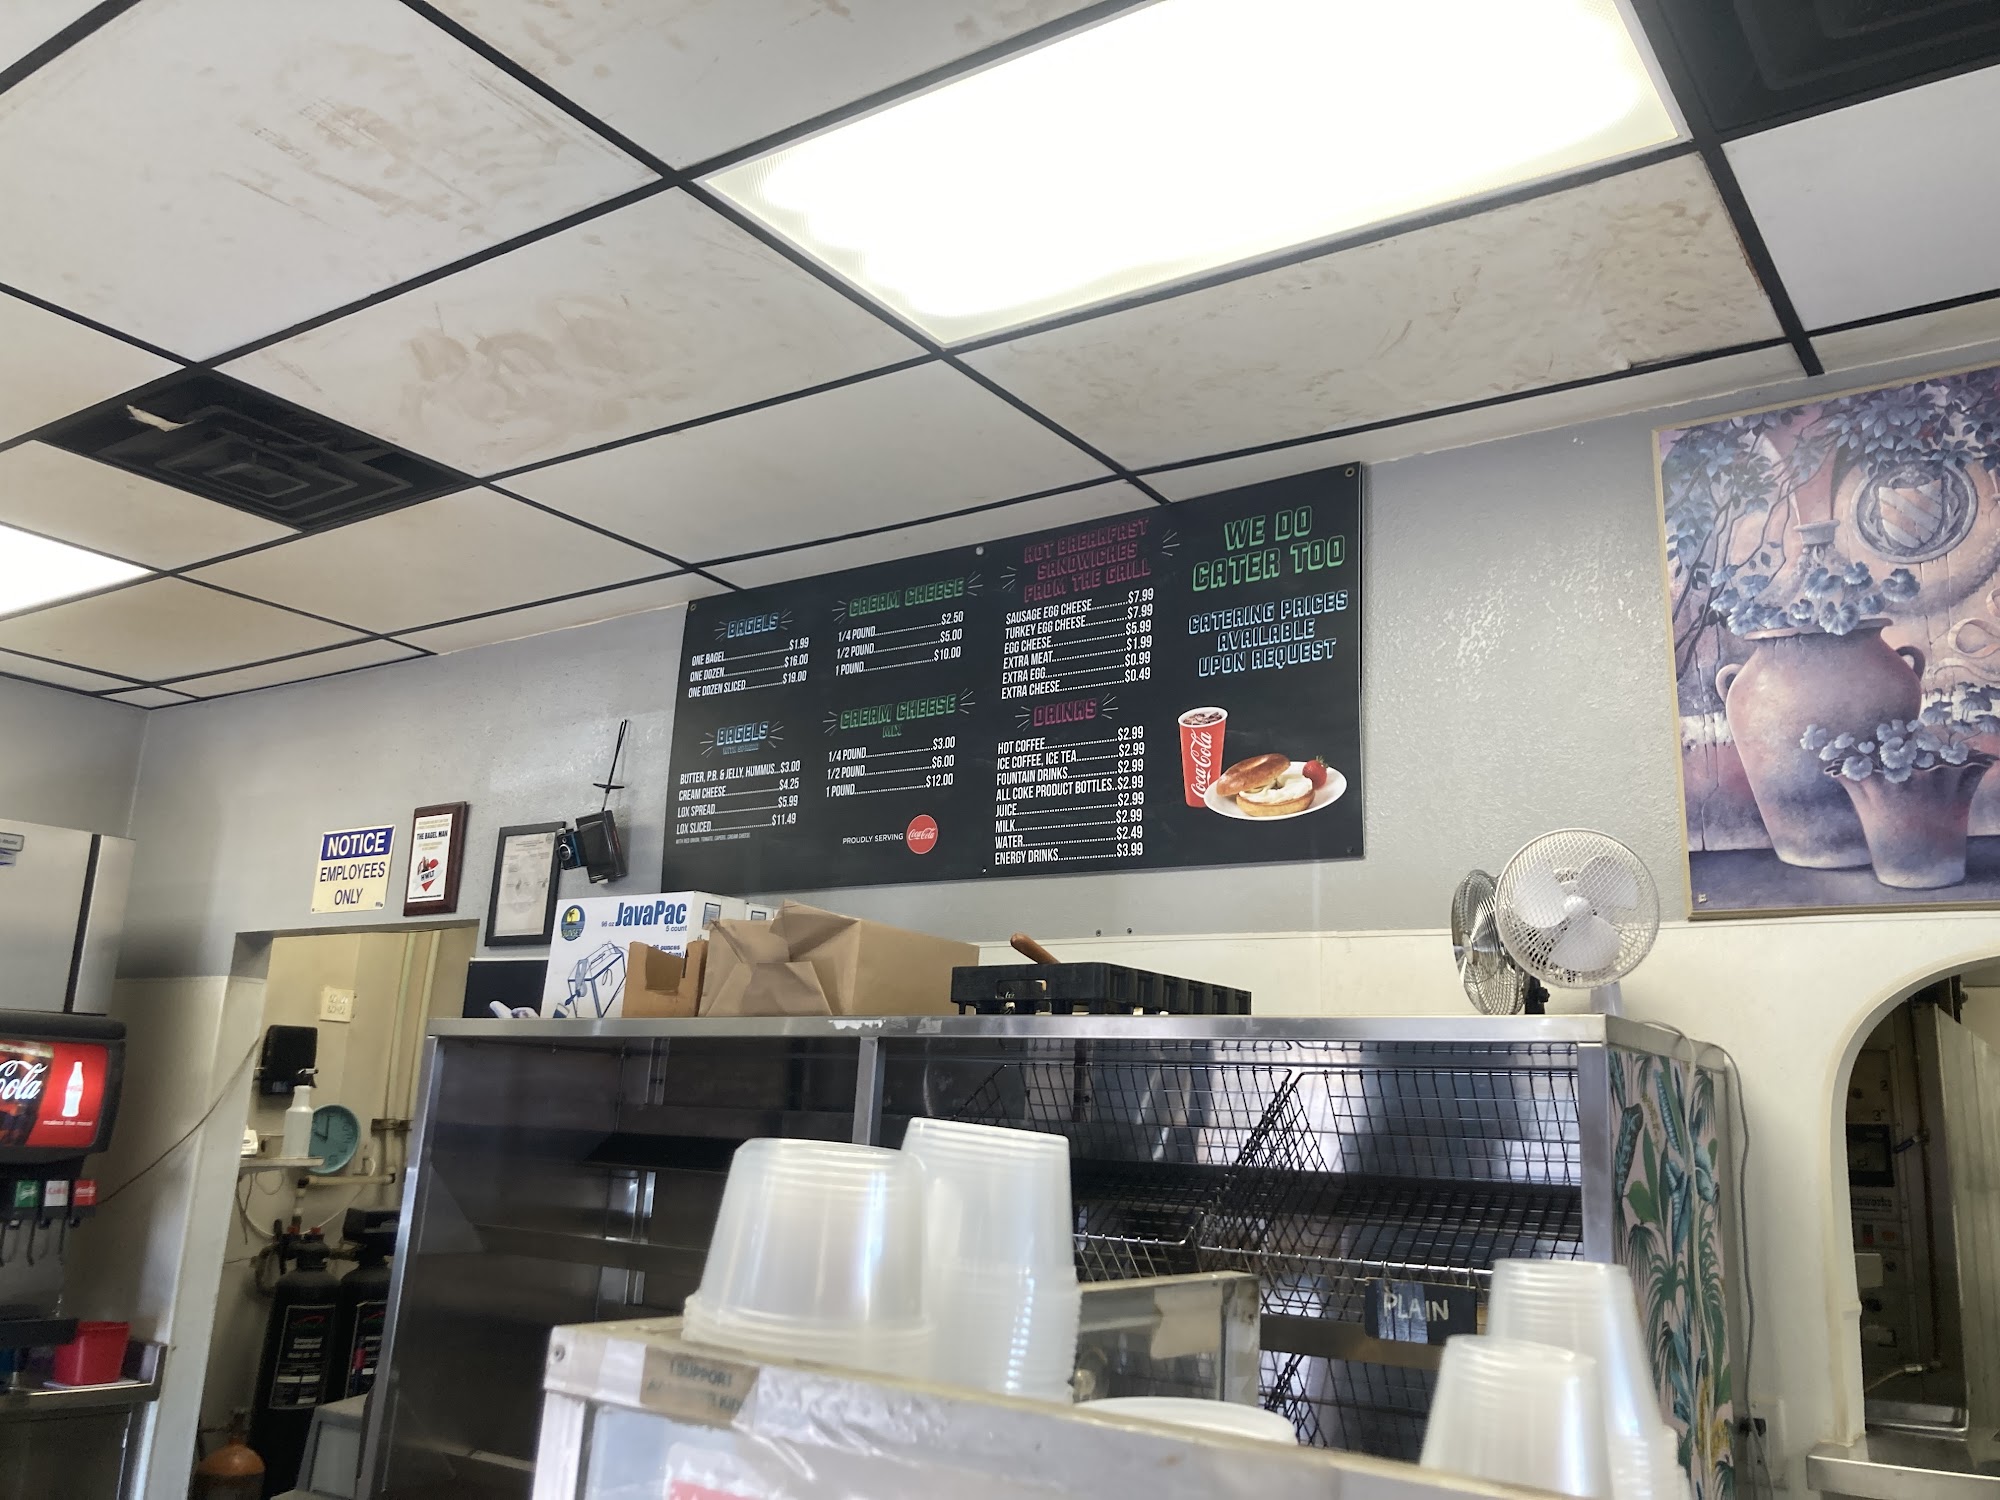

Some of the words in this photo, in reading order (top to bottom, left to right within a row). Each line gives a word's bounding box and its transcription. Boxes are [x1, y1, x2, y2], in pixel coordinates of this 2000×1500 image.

[1024, 543, 1054, 564] HOT
[1057, 517, 1149, 556] BREAKFAST
[1224, 515, 1266, 550] WE
[1275, 505, 1312, 541] DO
[1037, 541, 1138, 581] SANDWICHES
[1192, 548, 1280, 591] CATER
[1290, 535, 1345, 574] TOO
[1024, 578, 1066, 603] FROM
[1072, 569, 1100, 592] THE
[1106, 558, 1151, 584] GRILL
[849, 590, 901, 617] CREAM
[904, 577, 965, 606] CHEESE
[1005, 607, 1042, 625] SAUSAGE
[1043, 603, 1059, 618] EGG
[1060, 599, 1093, 616] CHEESE
[1128, 587, 1154, 604] $7.99
[1188, 602, 1274, 634] CATERING
[1281, 589, 1348, 620] PRICES
[727, 612, 779, 639] BAGELS
[838, 630, 851, 642] 1/4
[852, 626, 876, 640] POUND
[941, 611, 964, 626] $2.50
[1005, 622, 1037, 640] TURKEY
[1037, 619, 1053, 635] EGG
[1054, 615, 1087, 632] CHEESE
[1127, 603, 1153, 620] $7.99
[1217, 618, 1315, 652] AVAILABLE
[692, 654, 705, 667] ONE
[705, 651, 725, 665] BAGEL
[789, 636, 809, 651] $1.99
[836, 647, 850, 659] 1/2
[851, 643, 875, 657] POUND
[940, 628, 963, 643] $5.00
[1004, 640, 1020, 655] EGG
[1021, 636, 1052, 653] CHEESE
[1125, 619, 1152, 636] $5.99
[840, 661, 864, 675] POUND
[934, 646, 962, 662] $10.00
[1003, 655, 1029, 670] EXTRA
[1030, 650, 1053, 666] MEAT
[1126, 635, 1153, 651] $1.99
[1198, 651, 1246, 677] UPON
[1251, 637, 1336, 669] REQUEST
[690, 671, 703, 682] ONE
[703, 667, 725, 681] DOZEN
[784, 653, 809, 668] $16.00
[1002, 670, 1028, 685] EXTRA
[1029, 666, 1046, 681] EGG
[1124, 650, 1151, 667] $0.99
[688, 687, 701, 698] ONE
[702, 682, 723, 696] DOZEN
[723, 680, 746, 694] SLICED
[782, 670, 807, 685] $19.00
[1001, 685, 1028, 700] EXTRA
[1029, 680, 1061, 696] CHEESE
[1124, 666, 1151, 683] $0.49
[840, 704, 893, 730] CREAM
[897, 694, 957, 721] CHEESE
[1033, 698, 1097, 727] DRINKS
[717, 721, 770, 746] BAGELS
[997, 741, 1014, 755] HOT
[1015, 737, 1046, 752] COFFEE
[1117, 725, 1144, 742] $2.99
[828, 750, 842, 762] 1/4
[842, 746, 867, 760] POUND
[933, 736, 956, 750] $3.00
[997, 757, 1010, 770] ICE
[1011, 753, 1044, 768] COFFEE,
[1045, 751, 1059, 765] ICE
[1061, 750, 1077, 763] TEA
[1118, 742, 1145, 758] $2.99
[680, 771, 706, 785] BUTTER,
[706, 769, 719, 781] P.B.
[720, 769, 725, 780] &
[745, 764, 775, 777] HUMMUS
[780, 760, 800, 774] $3.00
[827, 768, 840, 780] 1/2
[841, 765, 865, 778] POUND
[931, 754, 955, 769] $6.00
[996, 769, 1036, 786] FOUNTAIN
[1037, 766, 1068, 782] DRINKS
[1117, 758, 1144, 774] $2.99
[679, 788, 701, 801] CREAM
[702, 785, 726, 799] CHEESE
[779, 777, 799, 791] $4.25
[831, 783, 855, 797] POUND
[926, 773, 954, 788] $12.00
[996, 788, 1011, 801] ALL
[1012, 785, 1033, 800] COKE
[1035, 781, 1074, 798] PRODUCT
[1075, 778, 1113, 794] BOTTLES
[1117, 775, 1144, 791] $2.99
[677, 806, 690, 818] LOX
[691, 803, 715, 816] SPREAD
[778, 795, 798, 809] $5.99
[996, 803, 1018, 818] JUICE
[1117, 791, 1144, 807] $2.99
[676, 824, 689, 835] LOX
[689, 821, 711, 833] SLICED
[771, 812, 796, 826] $11.49
[995, 819, 1016, 833] MILK
[1115, 808, 1142, 824] $2.99
[327, 831, 386, 857] NOTICE
[842, 835, 873, 845] PROUDLY
[875, 832, 904, 842] SERVING
[995, 834, 1024, 849] WATER
[1116, 825, 1143, 841] $2.49
[995, 850, 1026, 865] ENERGY
[1028, 848, 1059, 863] DRINKS
[1116, 842, 1143, 857] $3.99
[320, 861, 386, 882] EMPLOYEES
[334, 888, 363, 905] ONLY
[615, 900, 687, 927] JavaPac
[562, 928, 583, 938] SUNSET
[1383, 1292, 1449, 1321] PLAIN
